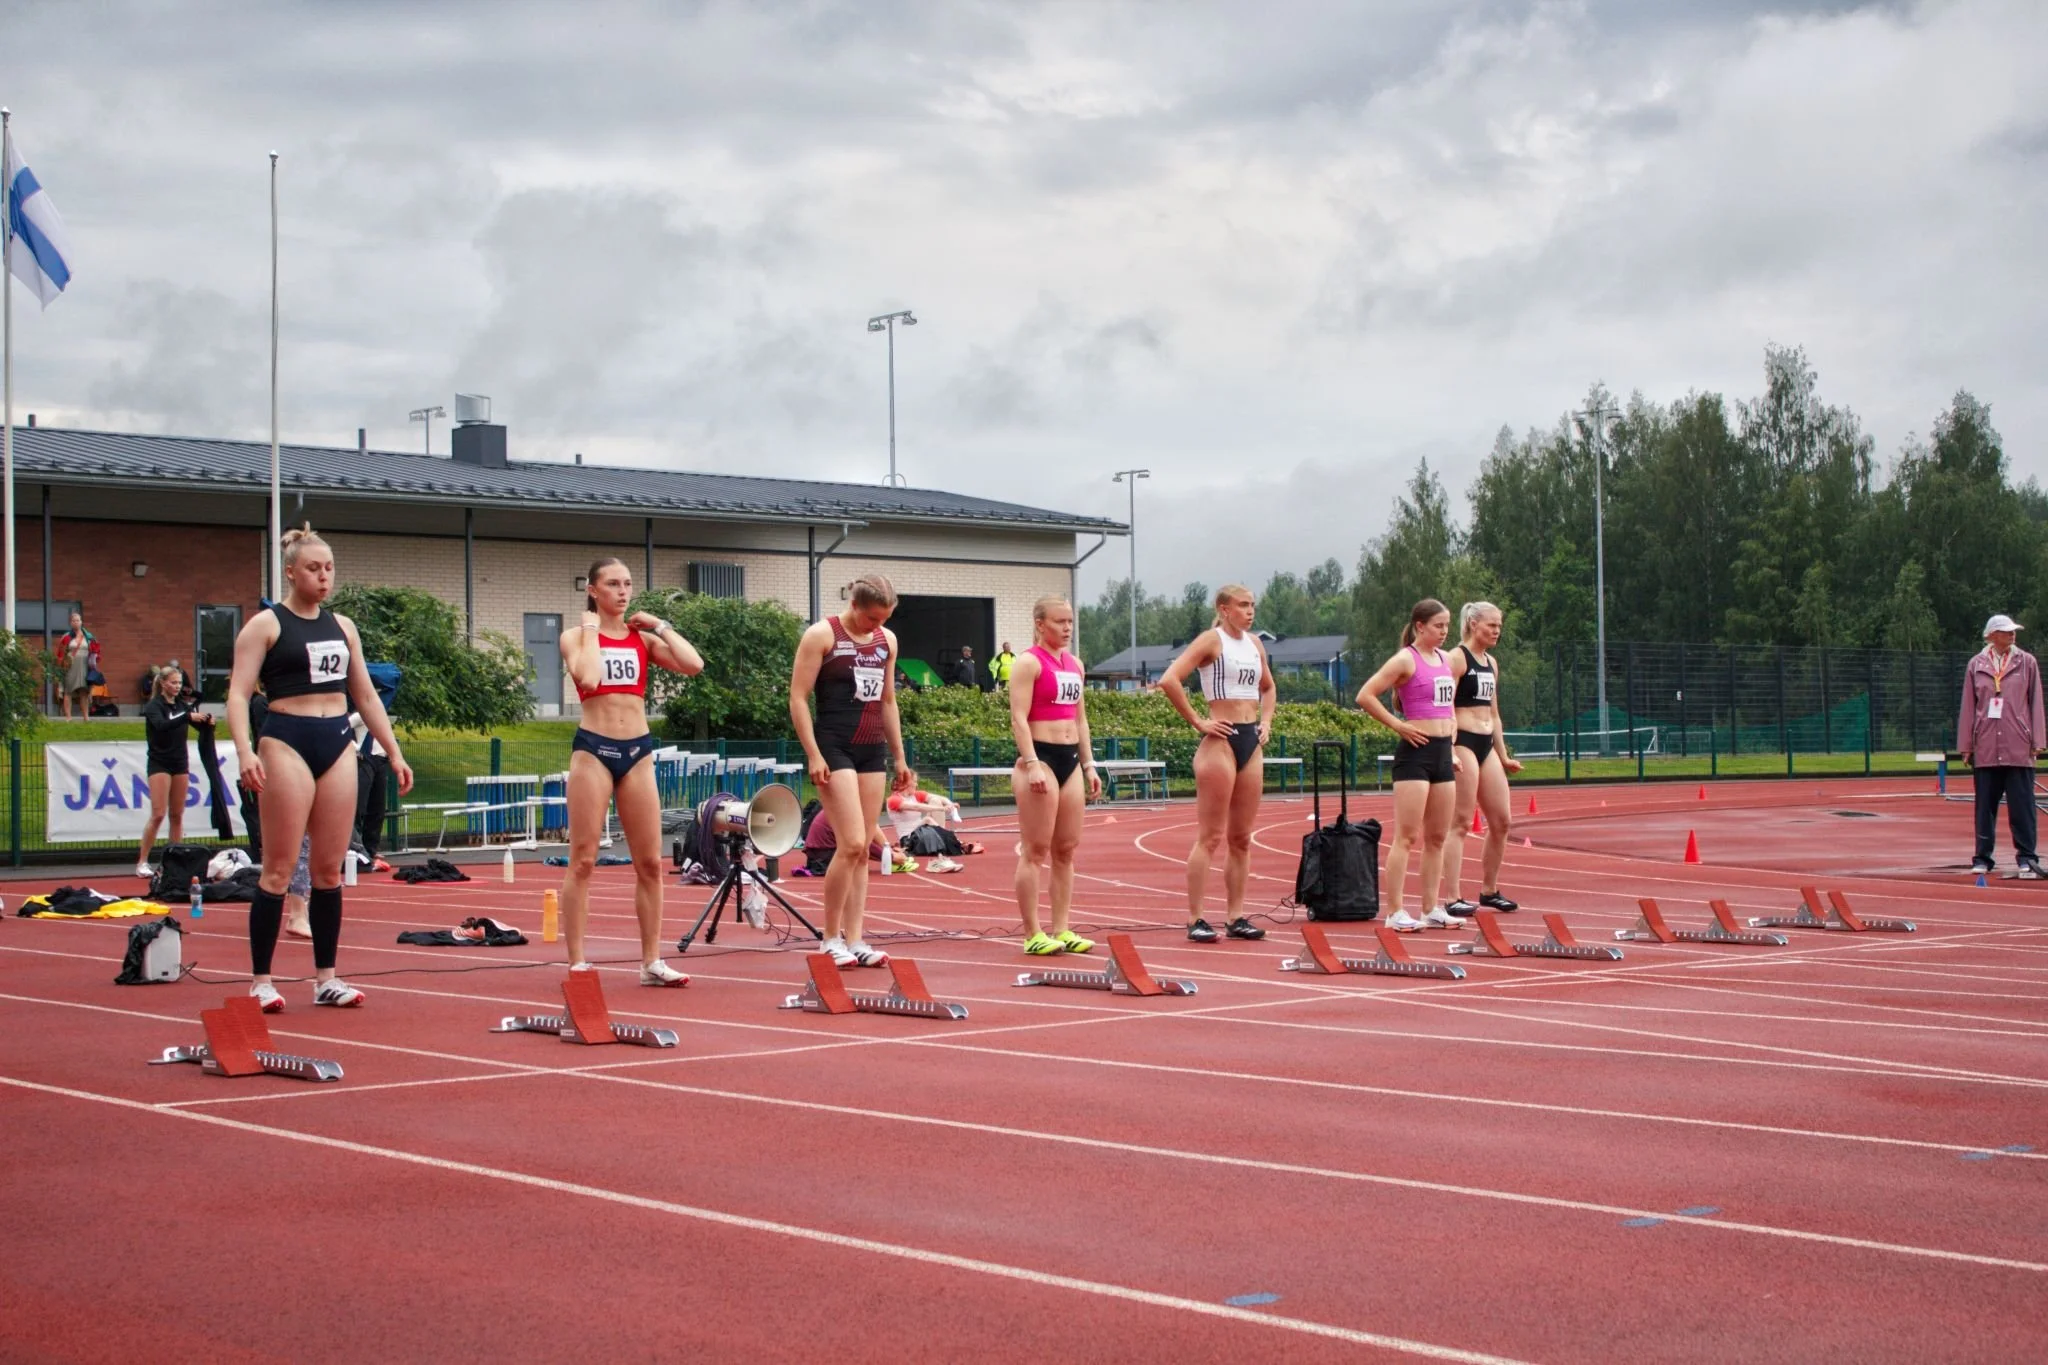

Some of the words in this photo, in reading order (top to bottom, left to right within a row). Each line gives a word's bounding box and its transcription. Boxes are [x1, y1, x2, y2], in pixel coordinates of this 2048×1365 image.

[318, 654, 341, 675] 42
[605, 659, 635, 680] 136
[1237, 668, 1255, 685] 178
[863, 679, 878, 697] 52
[1061, 682, 1080, 701] 148
[1439, 685, 1453, 702] 113
